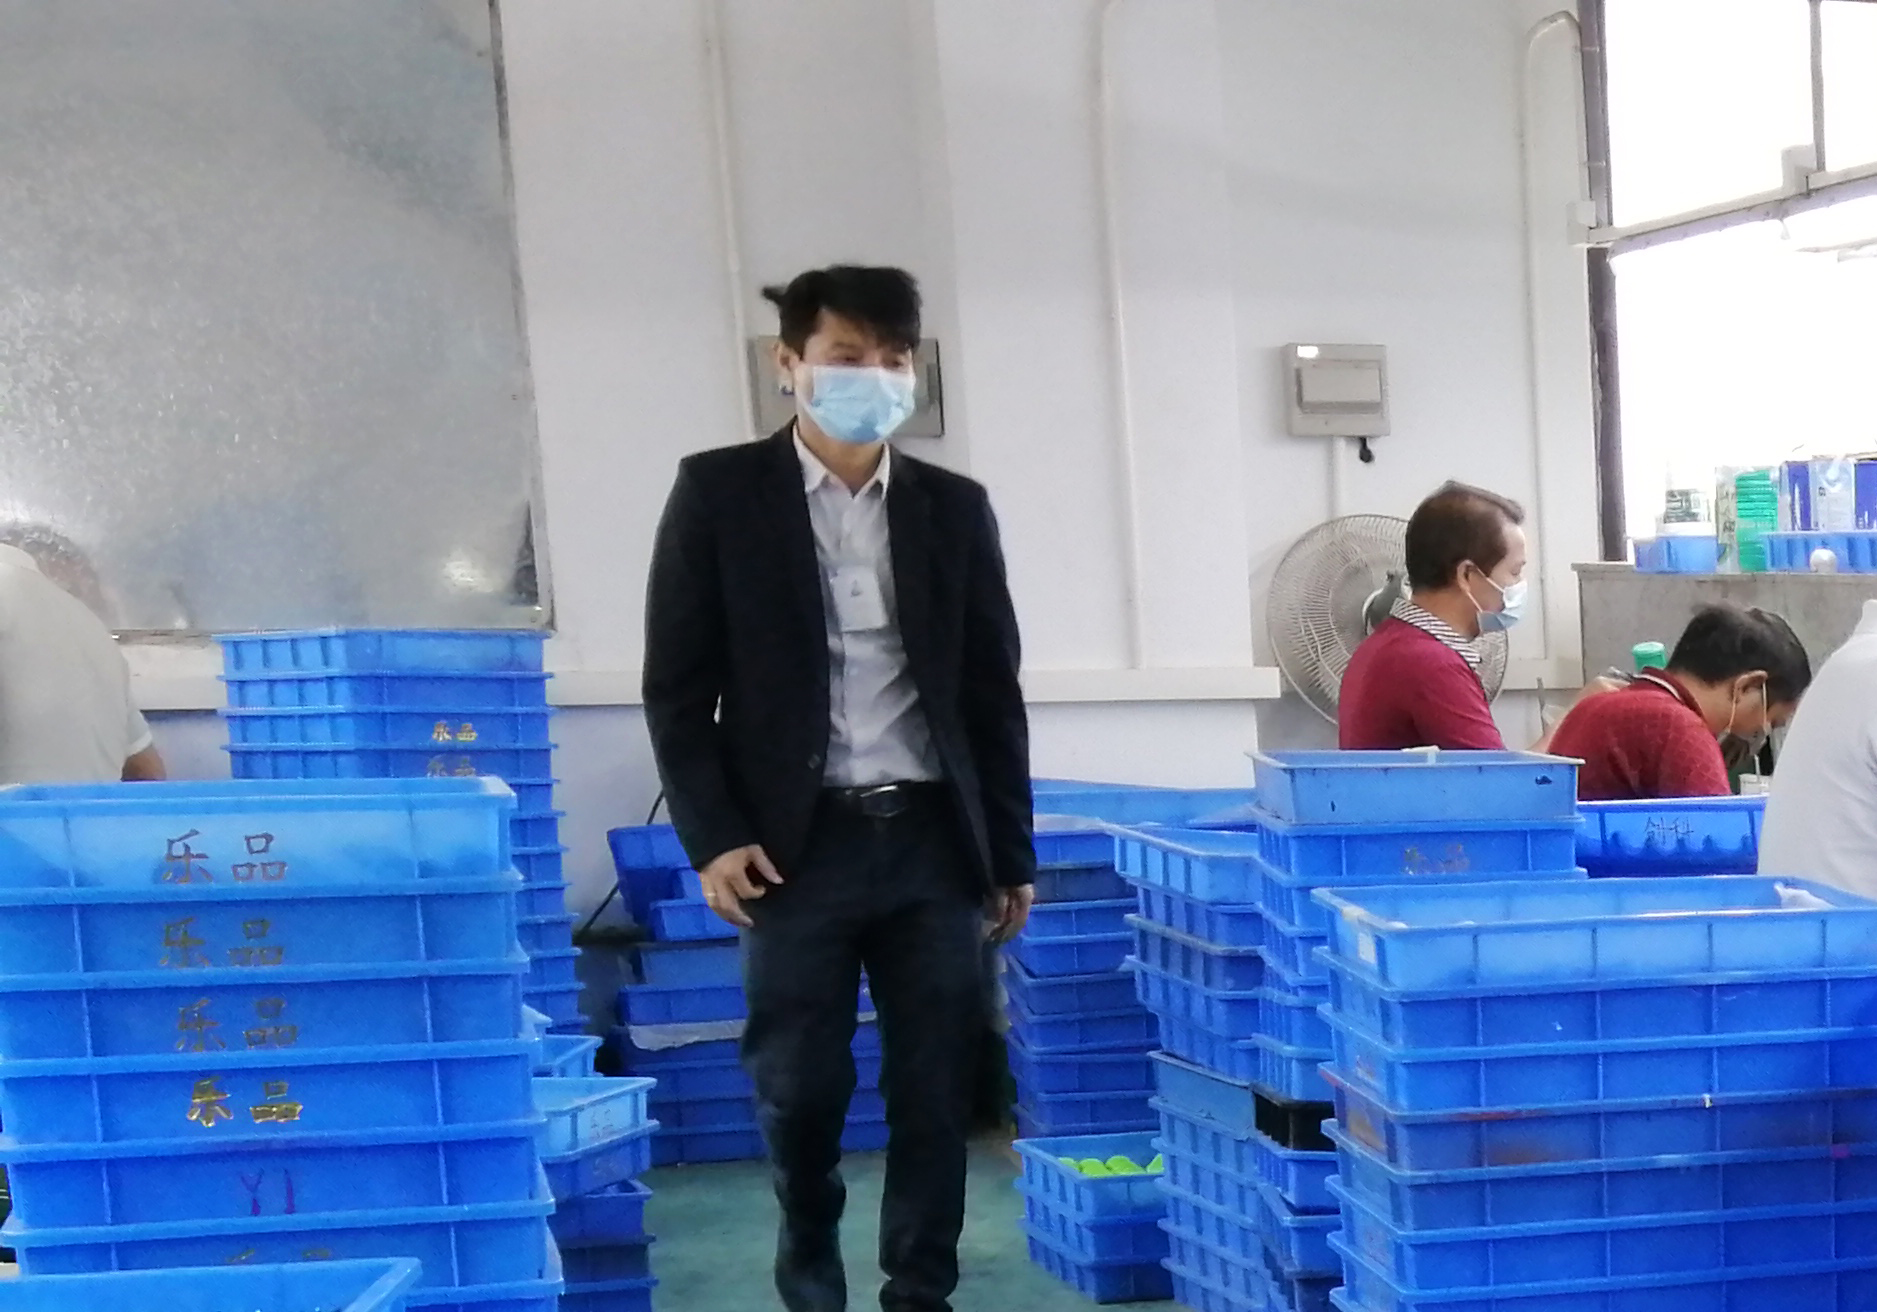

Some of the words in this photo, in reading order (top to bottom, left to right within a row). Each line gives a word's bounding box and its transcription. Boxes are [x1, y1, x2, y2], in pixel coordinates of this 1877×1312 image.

[162, 828, 288, 885] 乐品
[159, 916, 284, 968] 乐品
[176, 998, 298, 1051] 乐品
[186, 1075, 303, 1127] 乐品
